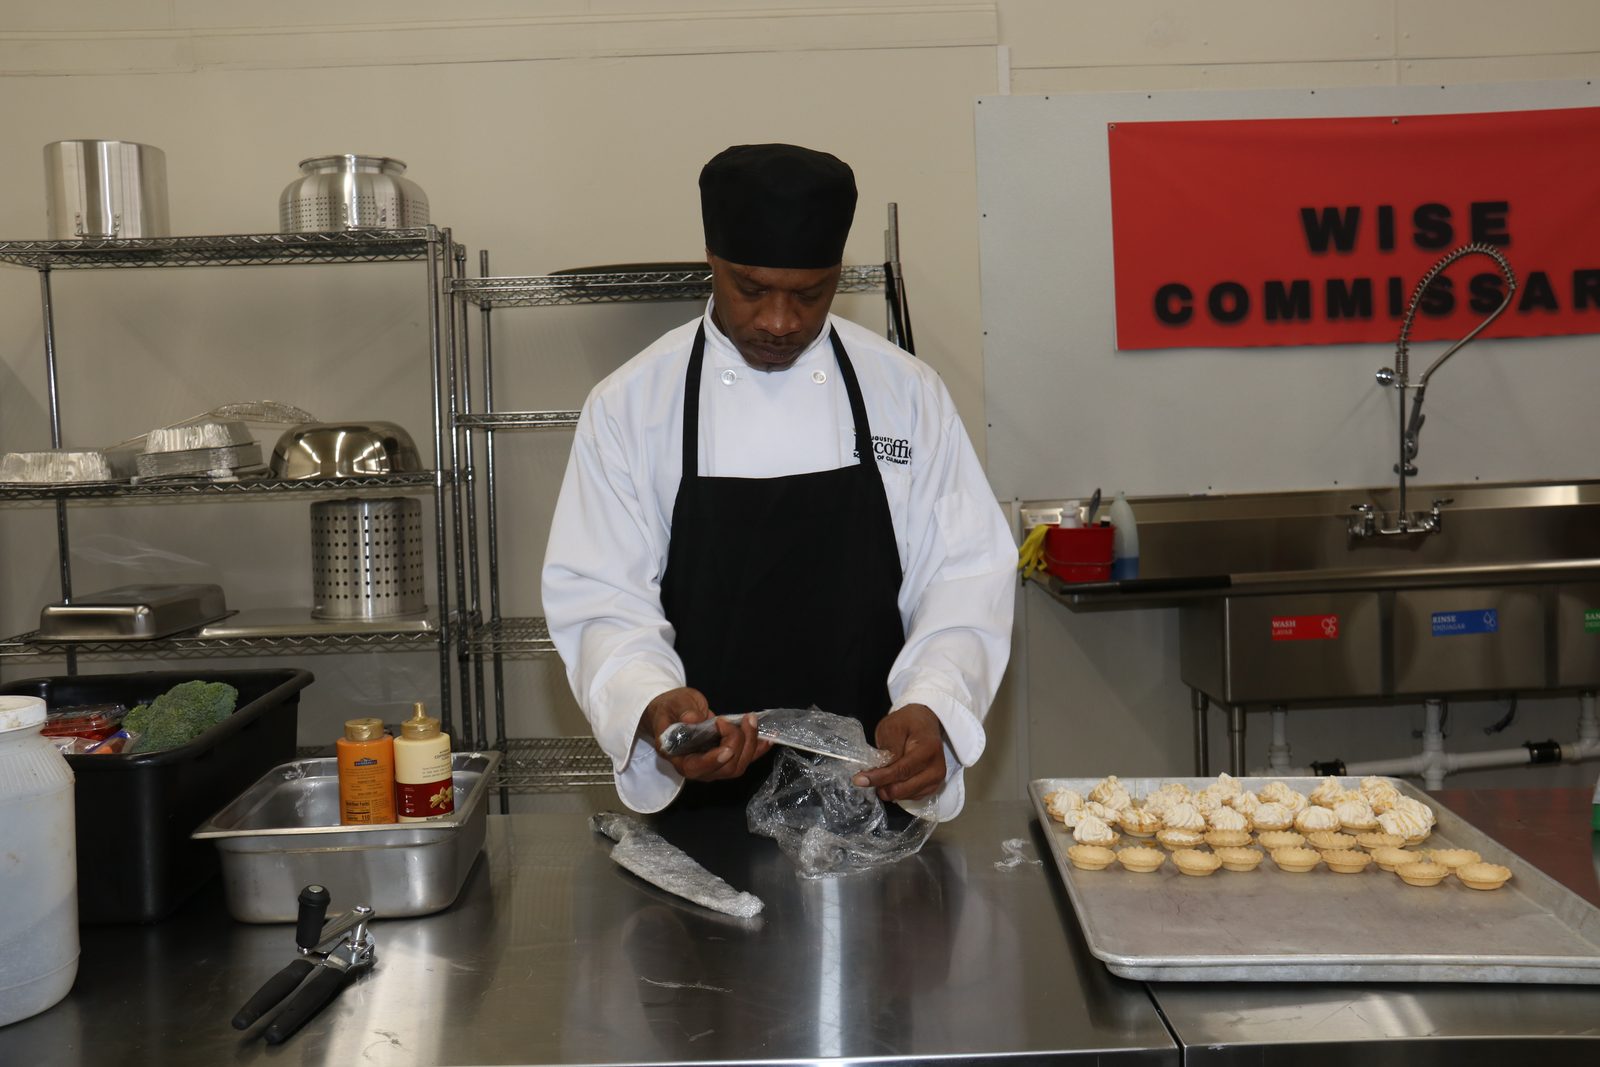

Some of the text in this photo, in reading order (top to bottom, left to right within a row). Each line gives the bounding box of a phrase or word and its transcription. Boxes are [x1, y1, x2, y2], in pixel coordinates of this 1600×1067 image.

[1300, 202, 1511, 254] WISE
[1272, 620, 1296, 628] WASH
[1432, 615, 1457, 624] RINSE
